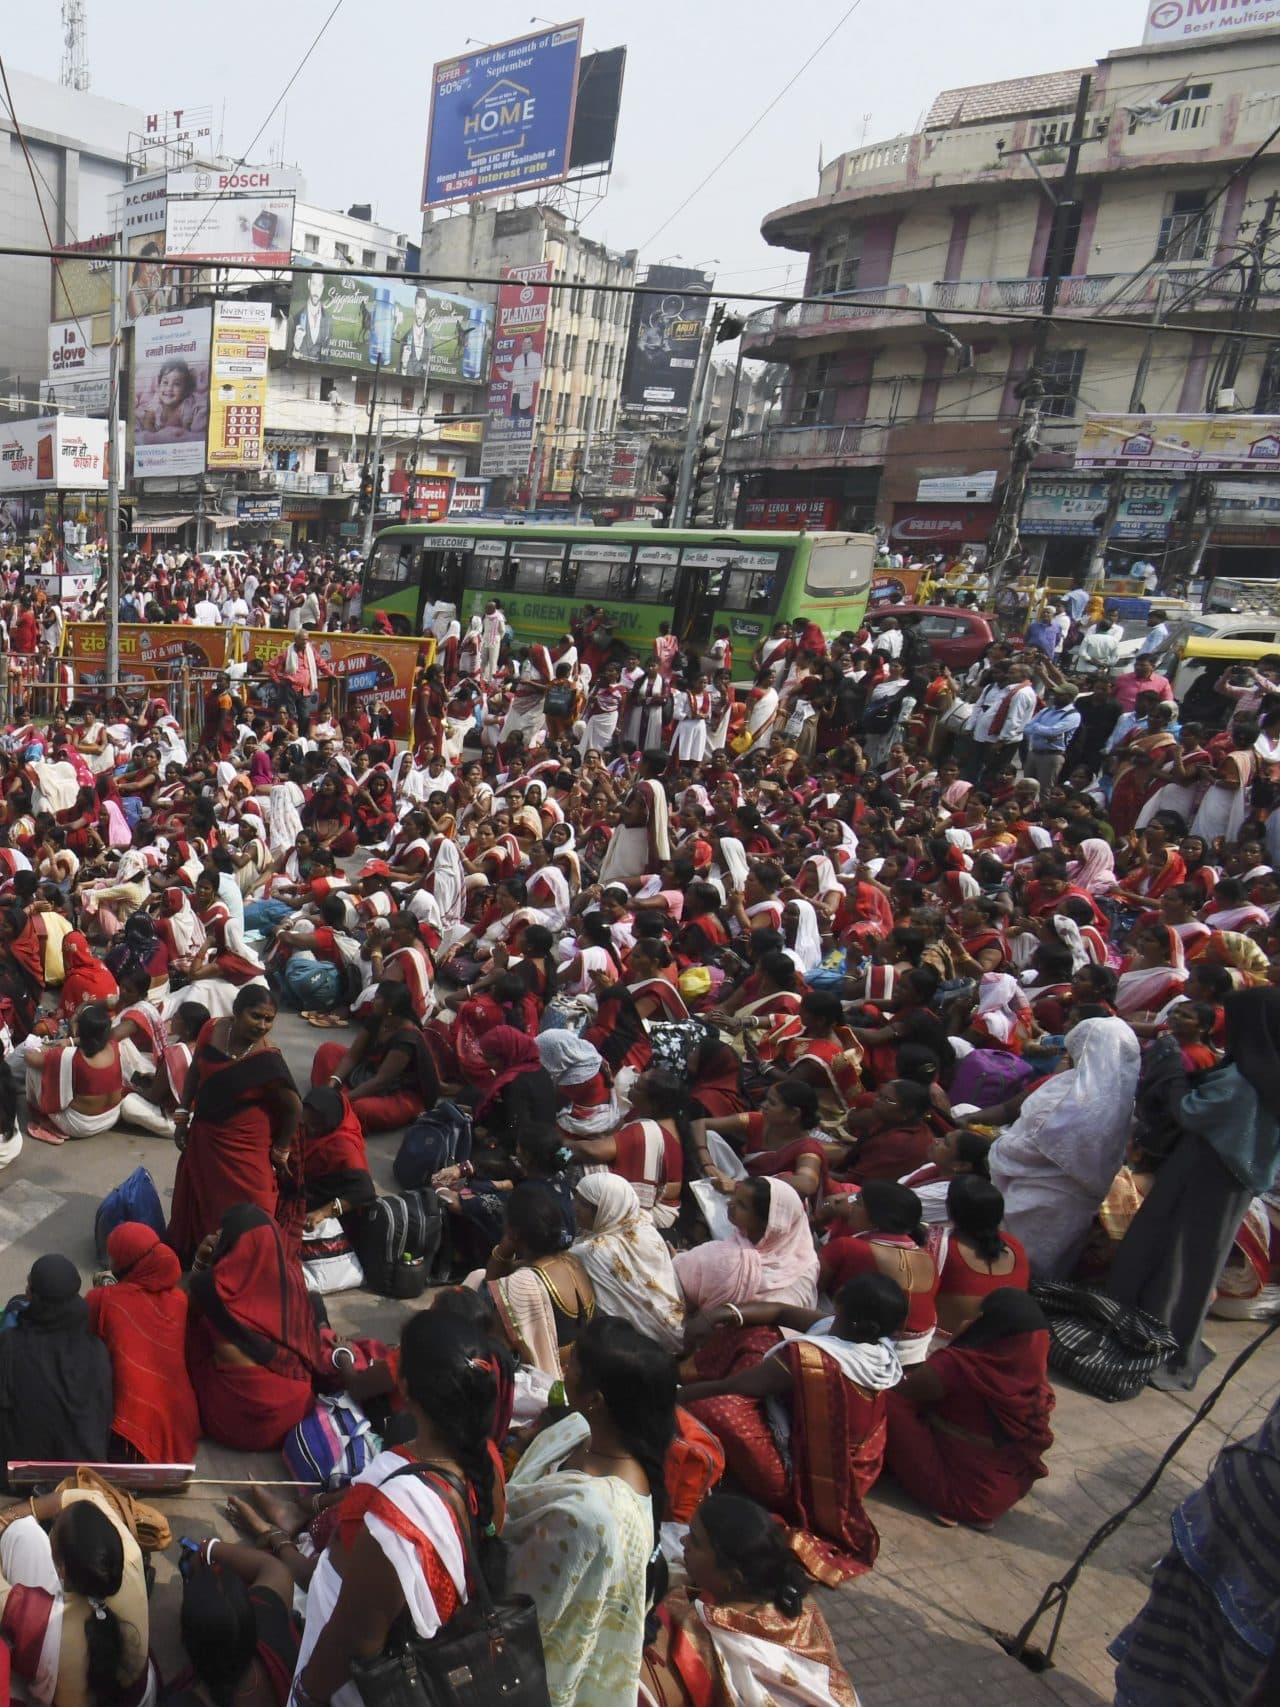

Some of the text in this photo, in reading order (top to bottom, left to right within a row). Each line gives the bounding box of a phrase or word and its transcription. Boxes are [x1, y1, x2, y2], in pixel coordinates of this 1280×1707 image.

[1184, 23, 1215, 34] Best
[475, 38, 550, 68] For the month of
[486, 57, 534, 79] September
[464, 98, 536, 136] HOME
[143, 135, 167, 146] LILLY
[219, 173, 270, 189] BOSCH
[436, 172, 457, 184] Home
[126, 209, 165, 227] JEWELLE
[500, 303, 547, 327] PLANNER
[64, 328, 76, 345] la
[52, 346, 86, 362] clove
[1029, 482, 1090, 499] प्रकाश
[908, 519, 964, 530] RUPA
[430, 536, 469, 548] WELCOME
[523, 603, 566, 621] GREEN
[141, 649, 158, 662] BUY
[167, 642, 184, 655] WIN
[347, 656, 367, 669] WIN
